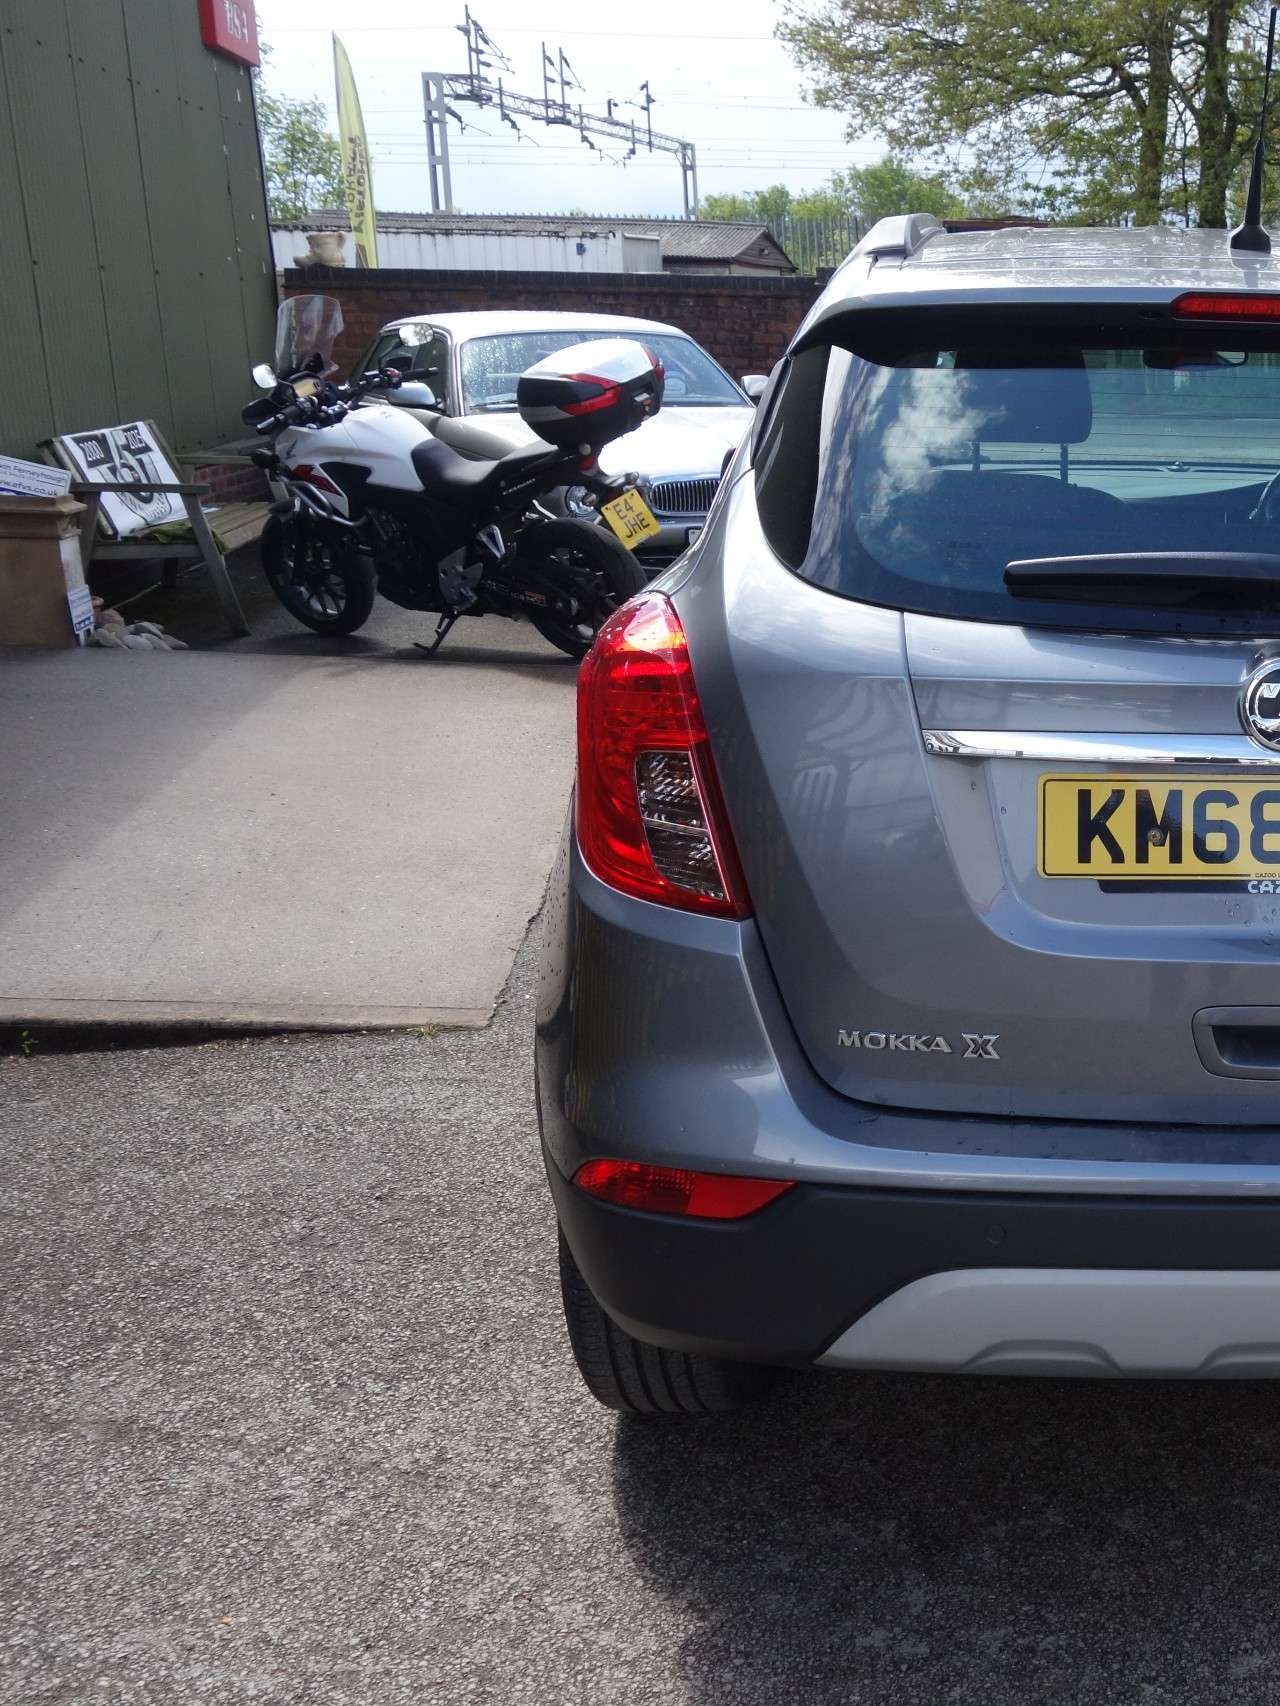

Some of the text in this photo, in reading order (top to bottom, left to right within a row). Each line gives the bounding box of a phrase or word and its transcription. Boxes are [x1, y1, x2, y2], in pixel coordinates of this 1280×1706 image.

[80, 440, 105, 461] 2000
[613, 498, 634, 521] E4
[624, 512, 651, 539] JHE
[837, 1029, 1001, 1060] MOKKA X
